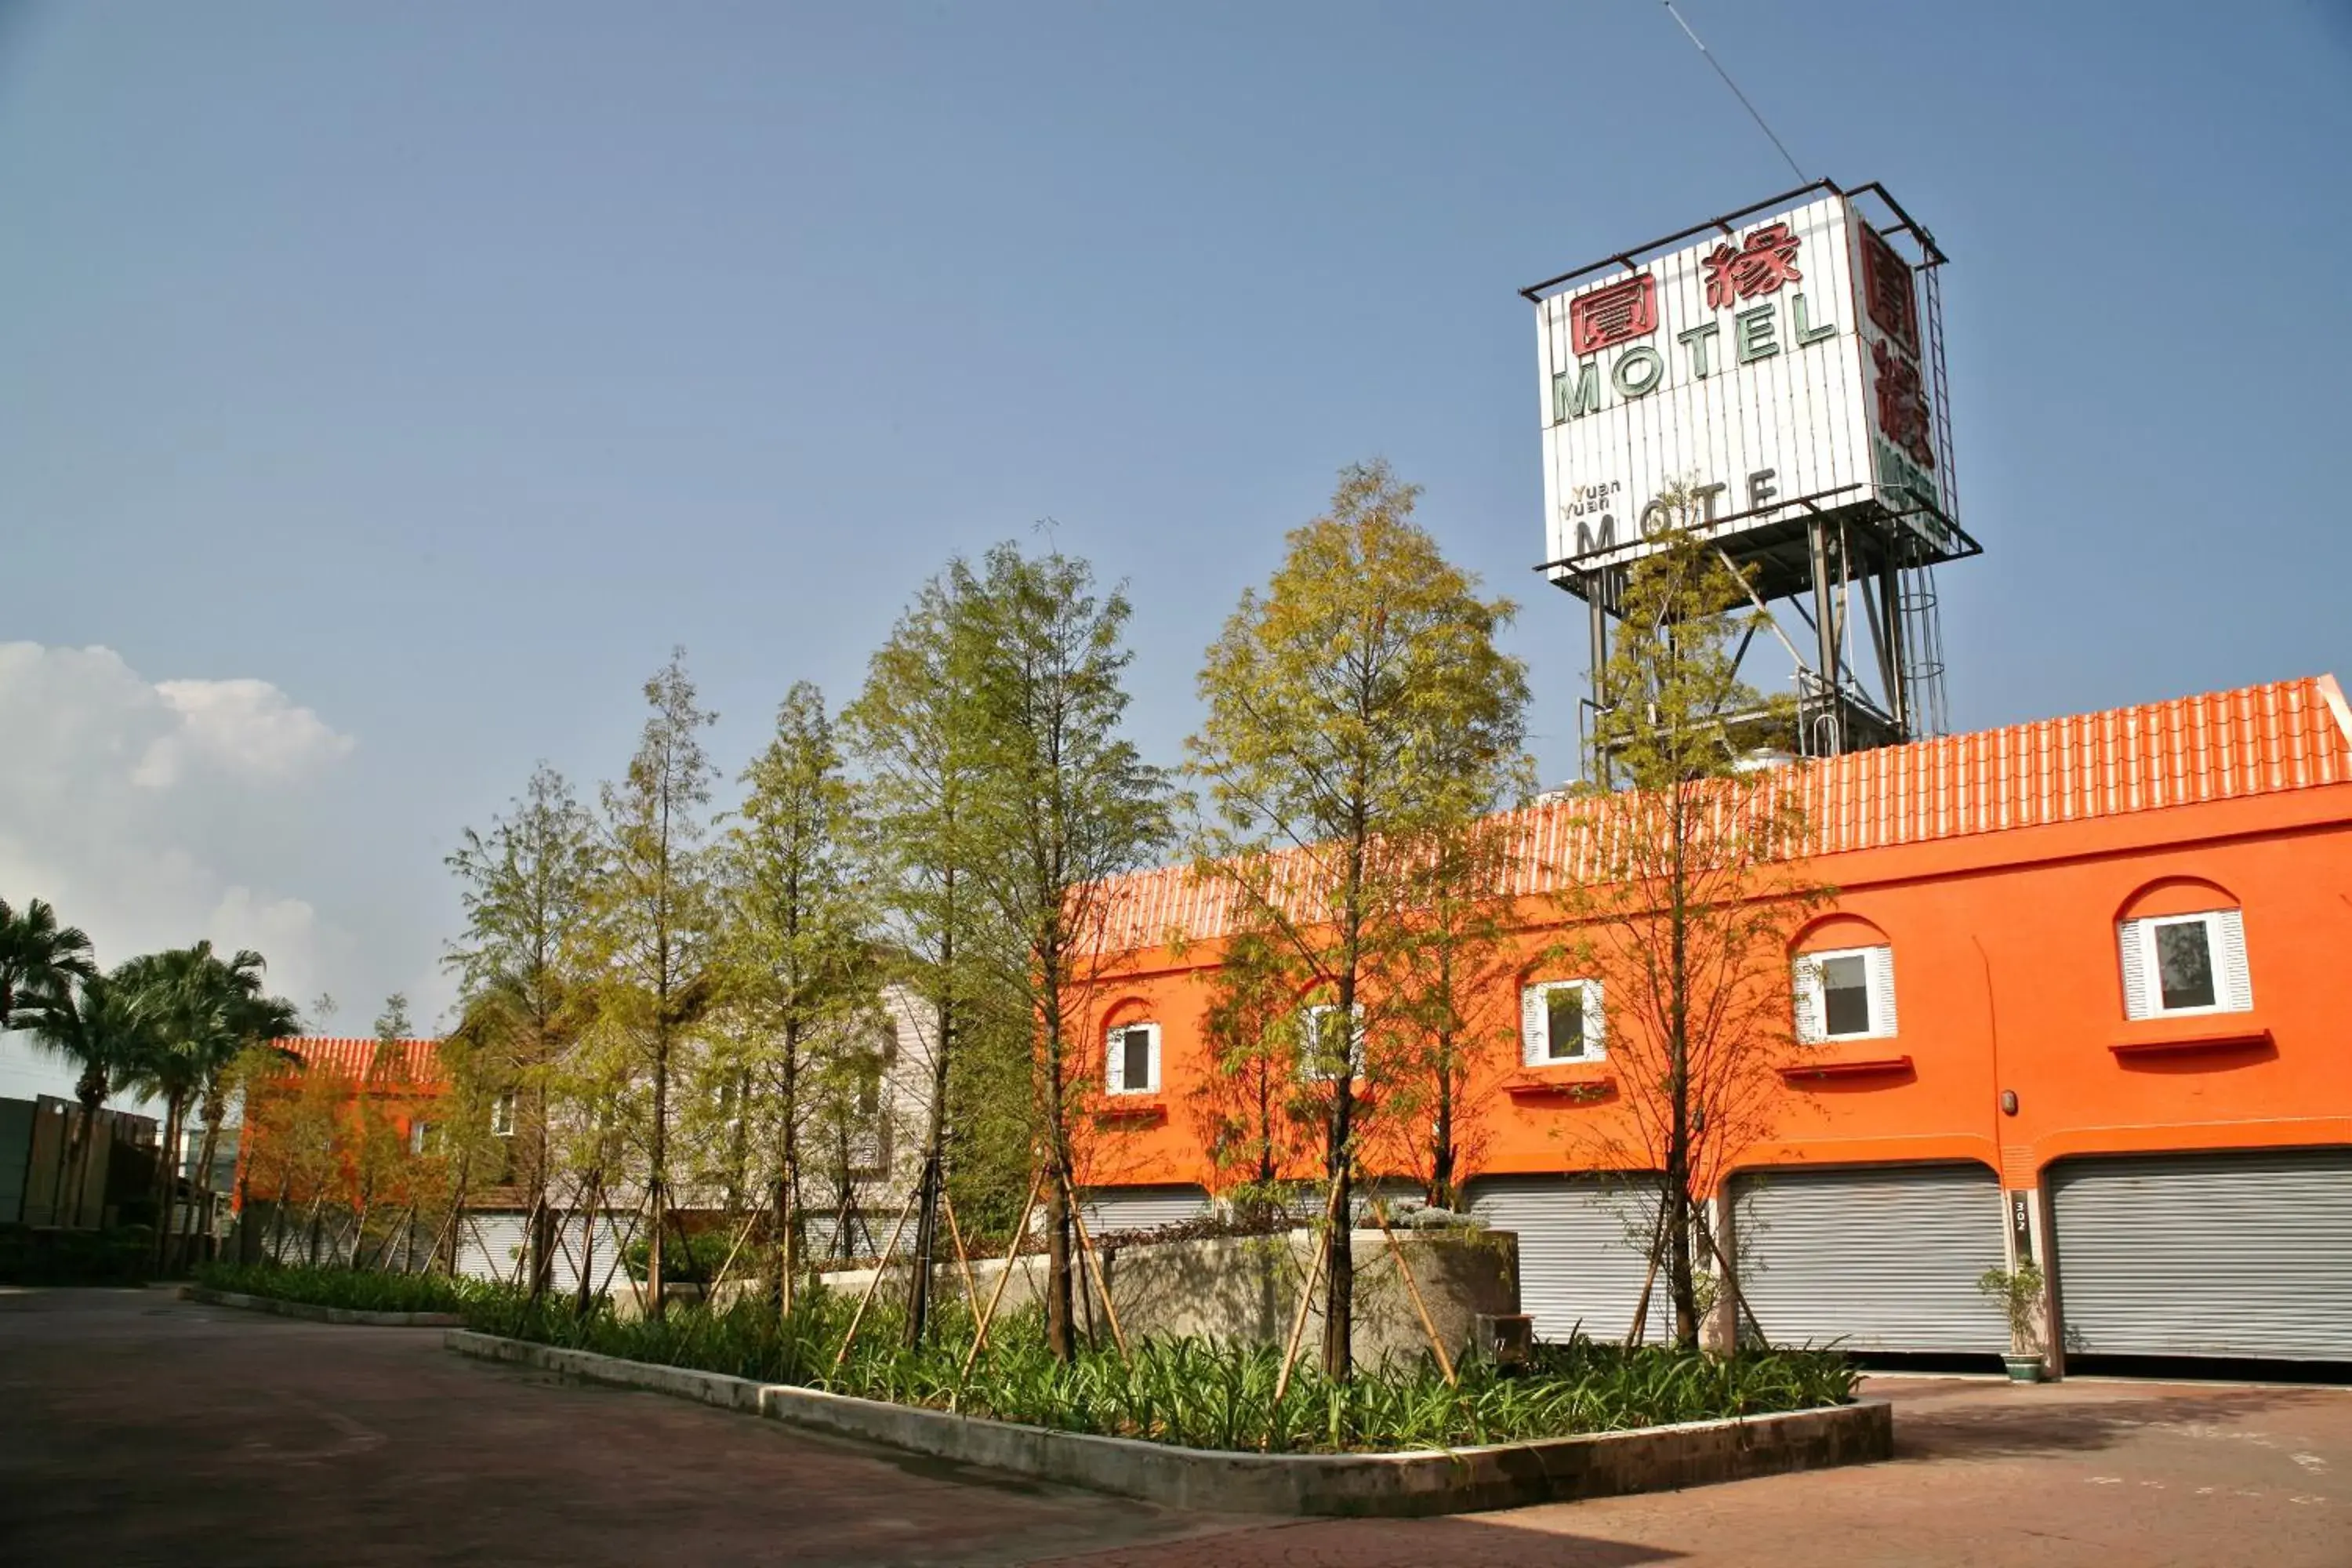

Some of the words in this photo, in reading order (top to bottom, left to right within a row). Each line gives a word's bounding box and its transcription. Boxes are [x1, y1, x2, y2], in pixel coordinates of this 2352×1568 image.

[1552, 292, 1836, 426] MOTEL
[1572, 479, 1621, 503] Yuan
[1561, 497, 1610, 520] Yuan
[1577, 468, 1778, 564] MOTE
[2016, 1202, 2025, 1230] 302
